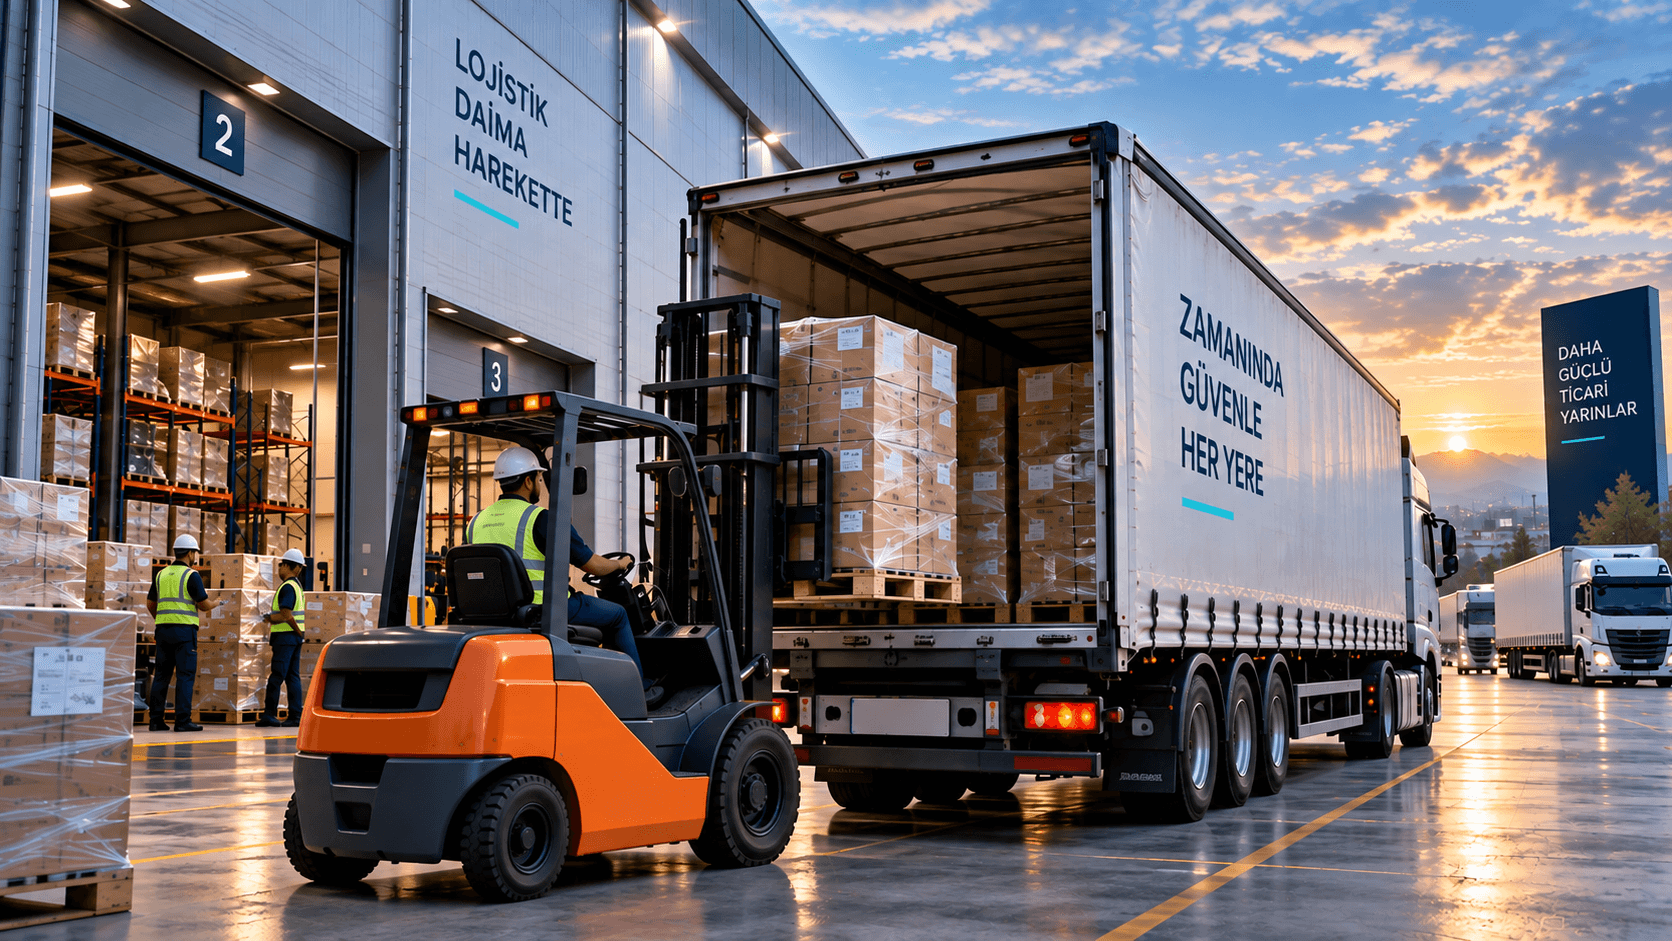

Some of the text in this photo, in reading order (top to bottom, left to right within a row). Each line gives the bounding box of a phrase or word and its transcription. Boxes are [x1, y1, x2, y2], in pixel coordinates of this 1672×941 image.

[455, 37, 548, 128] LOJİSTİK
[215, 113, 233, 157] 2
[455, 86, 528, 158] DAİMA
[455, 134, 573, 227] HAREKETTE
[1180, 293, 1284, 397] ZAMANINDA
[1558, 340, 1603, 361] DAHA
[1558, 357, 1612, 381] GÜÇLÜ
[491, 361, 501, 392] 3
[1180, 360, 1262, 440] GÜVENLE
[1559, 379, 1608, 403] TİCARİ
[1560, 401, 1637, 425] YARINLAR
[1181, 426, 1264, 496] HER YERE
